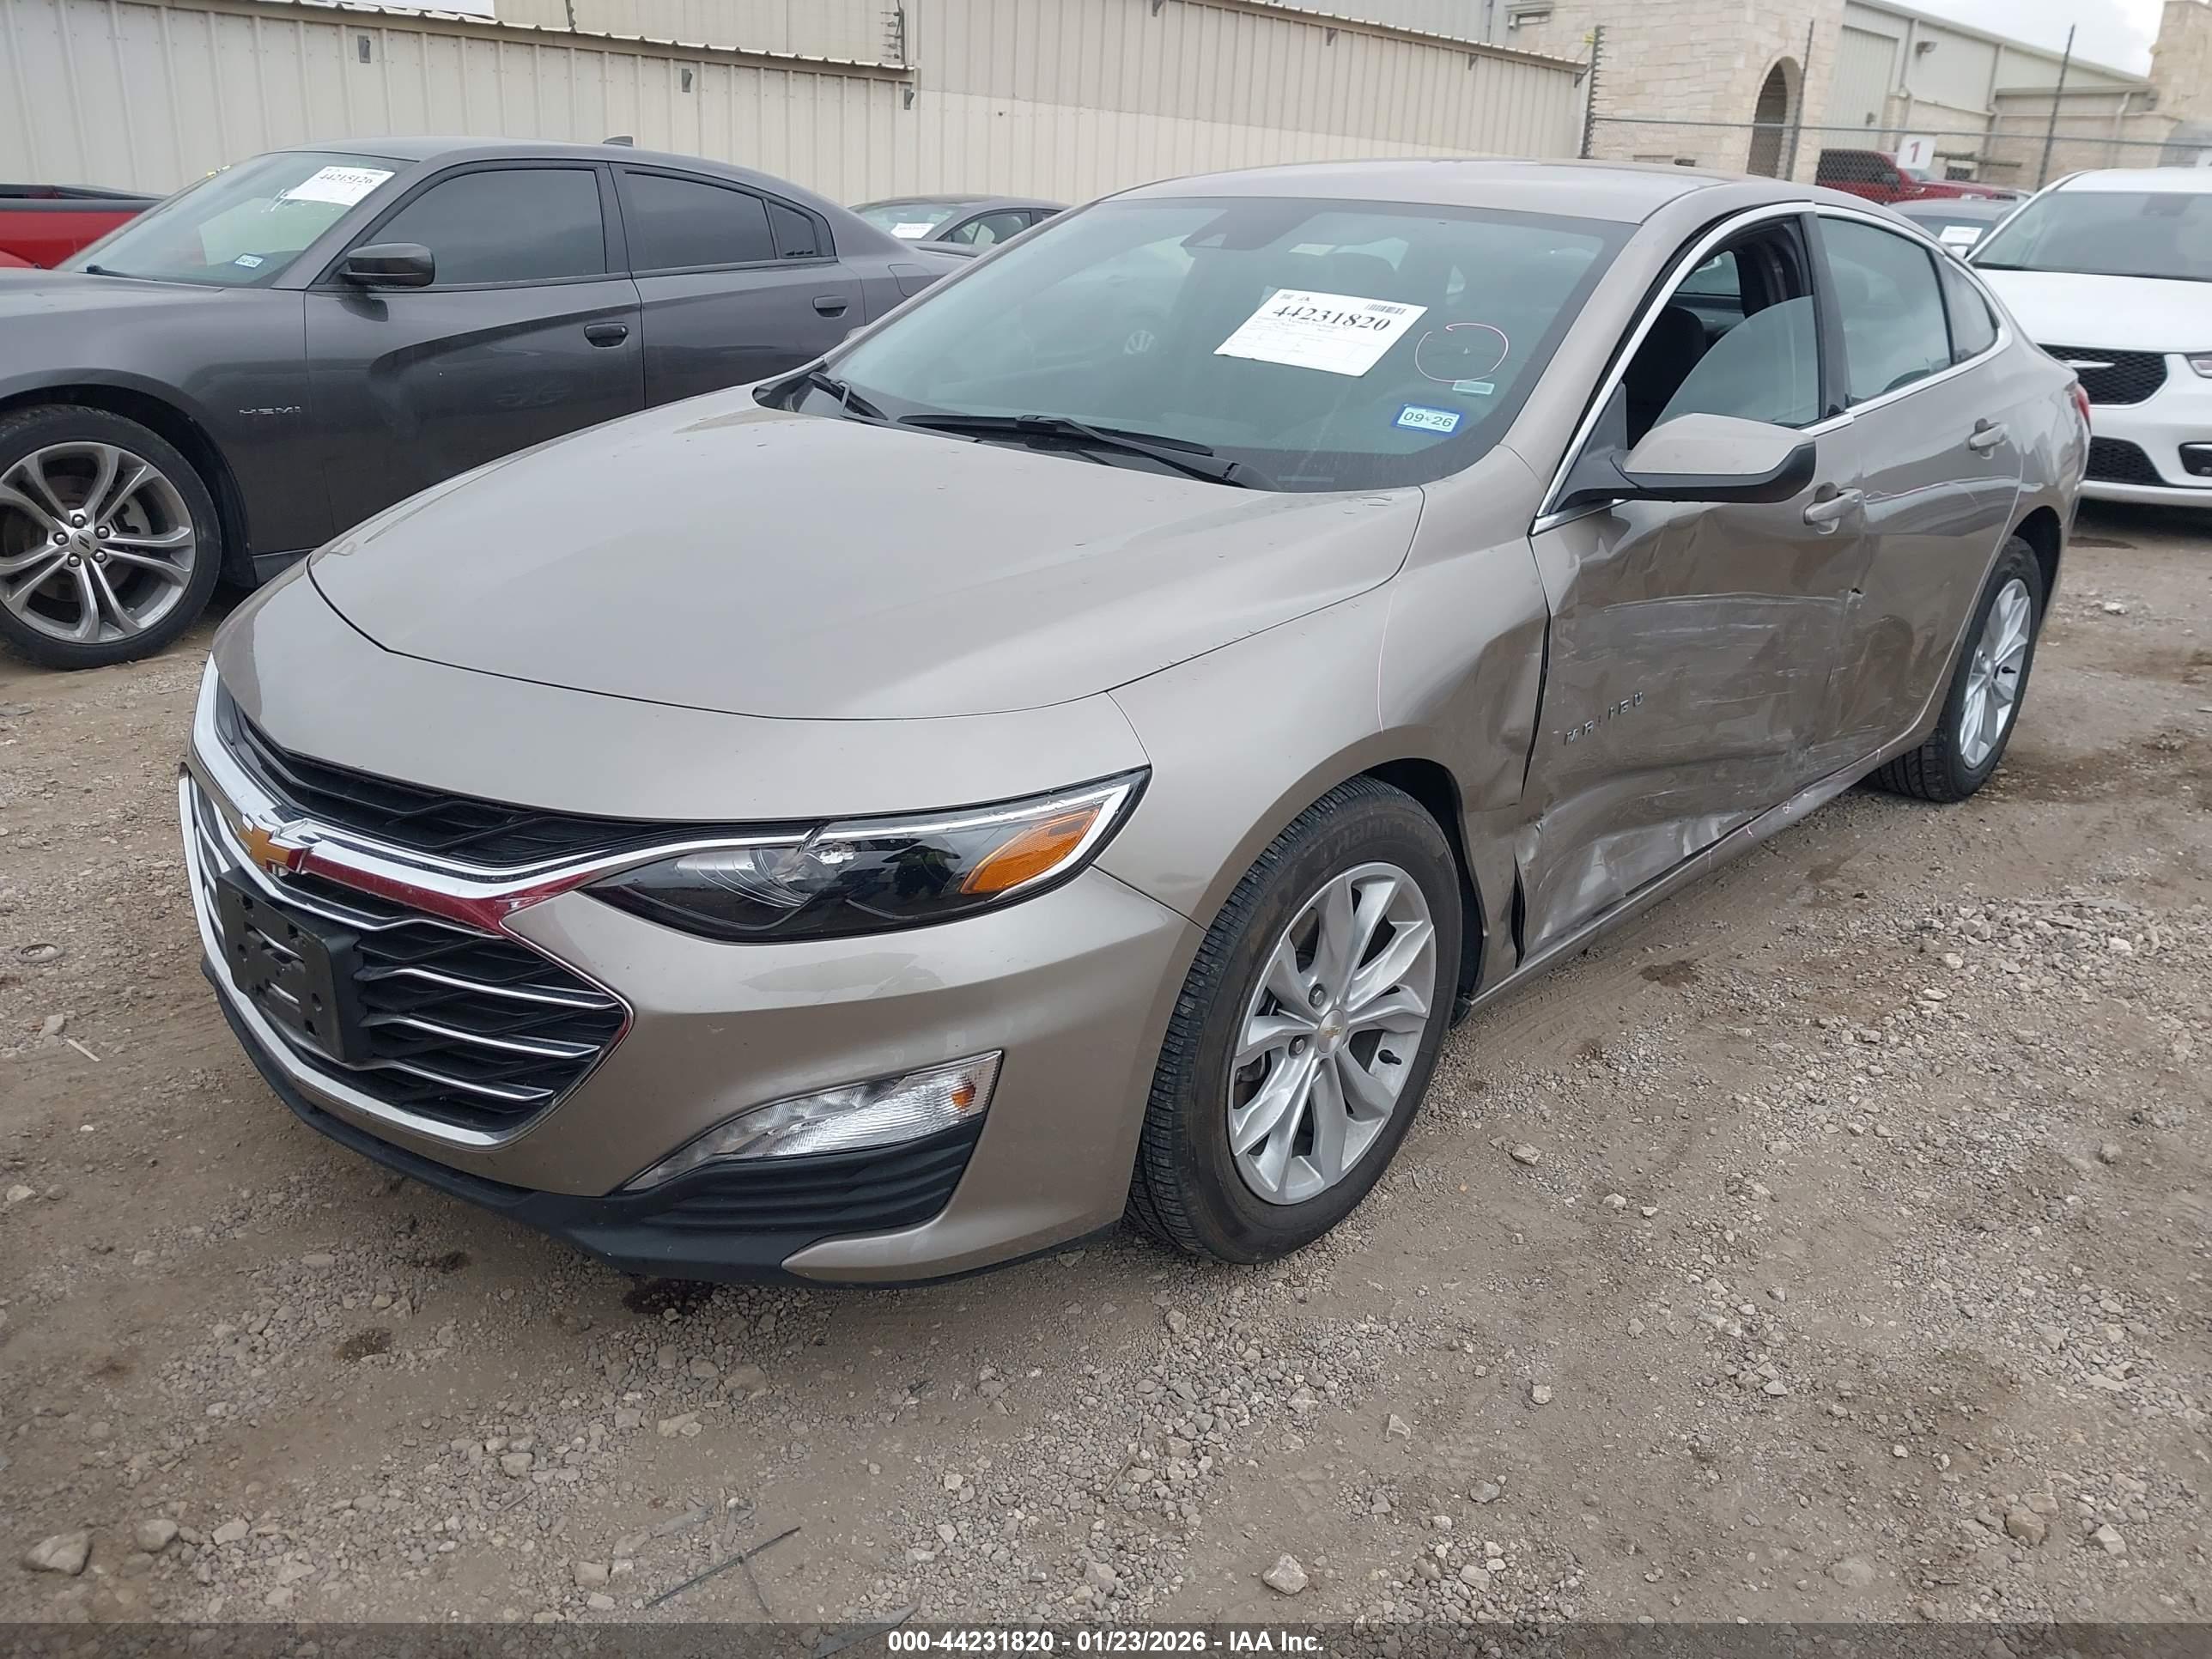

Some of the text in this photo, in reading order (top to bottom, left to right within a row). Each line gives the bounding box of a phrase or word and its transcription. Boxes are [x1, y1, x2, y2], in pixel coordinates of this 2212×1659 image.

[1910, 141, 1921, 163] 1
[1273, 305, 1391, 331] 44231820
[239, 406, 301, 415] HEMI
